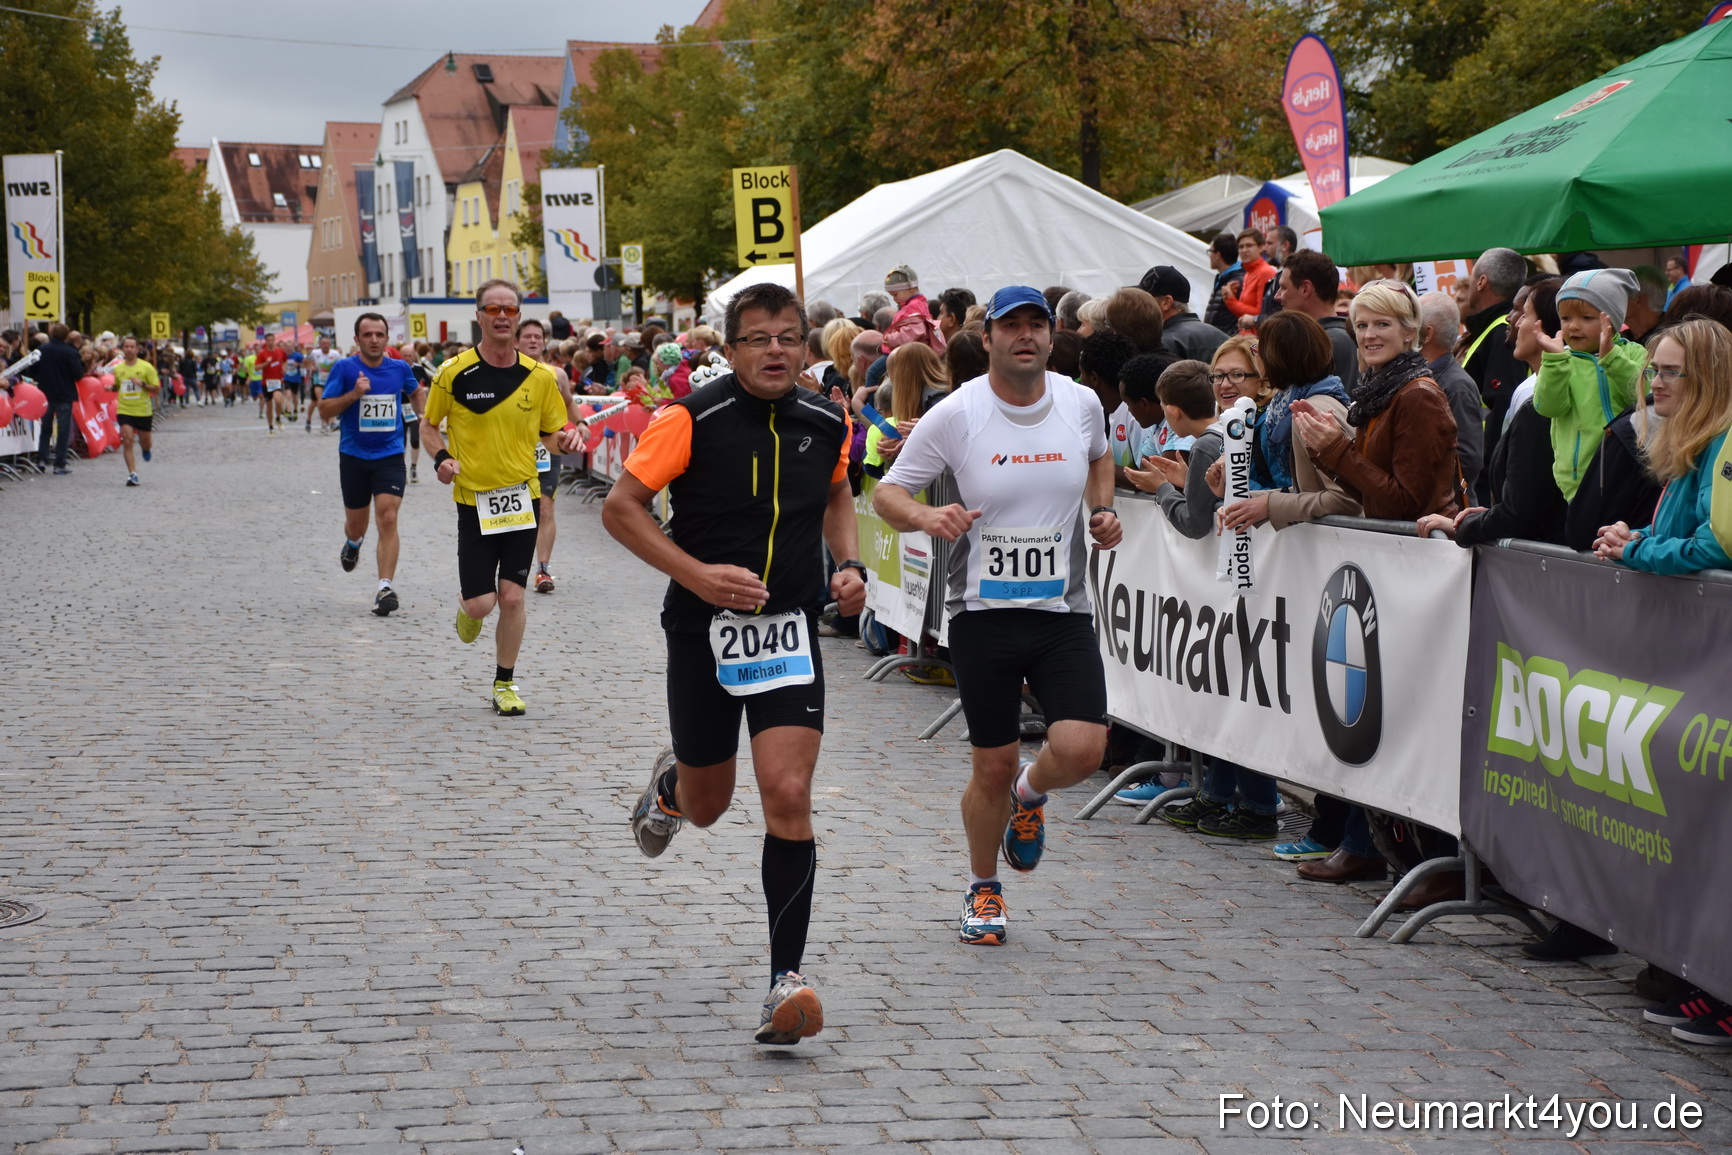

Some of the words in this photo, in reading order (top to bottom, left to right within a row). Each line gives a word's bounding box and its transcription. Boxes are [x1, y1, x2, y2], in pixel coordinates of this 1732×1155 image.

[741, 171, 790, 189] Block
[752, 197, 784, 244] B
[28, 273, 55, 283] Block
[33, 286, 50, 309] C
[156, 321, 165, 333] D
[414, 320, 423, 333] D
[466, 392, 495, 400] Markus
[363, 403, 394, 418] 2171
[1011, 452, 1067, 464] KLEBL
[1230, 451, 1249, 499] BMW
[488, 494, 522, 515] 525
[981, 534, 1008, 543] PARTL
[1010, 535, 1052, 544] Neumarkt
[988, 546, 1056, 577] 3101
[1321, 570, 1376, 638] BMW
[720, 620, 800, 660] 2040
[1090, 549, 1291, 714] Neumarkt
[737, 661, 787, 682] Michael
[1495, 657, 1666, 796] BOCK
[1483, 760, 1548, 810] inspired
[1560, 797, 1599, 837] smart
[1602, 814, 1673, 866] concepts
